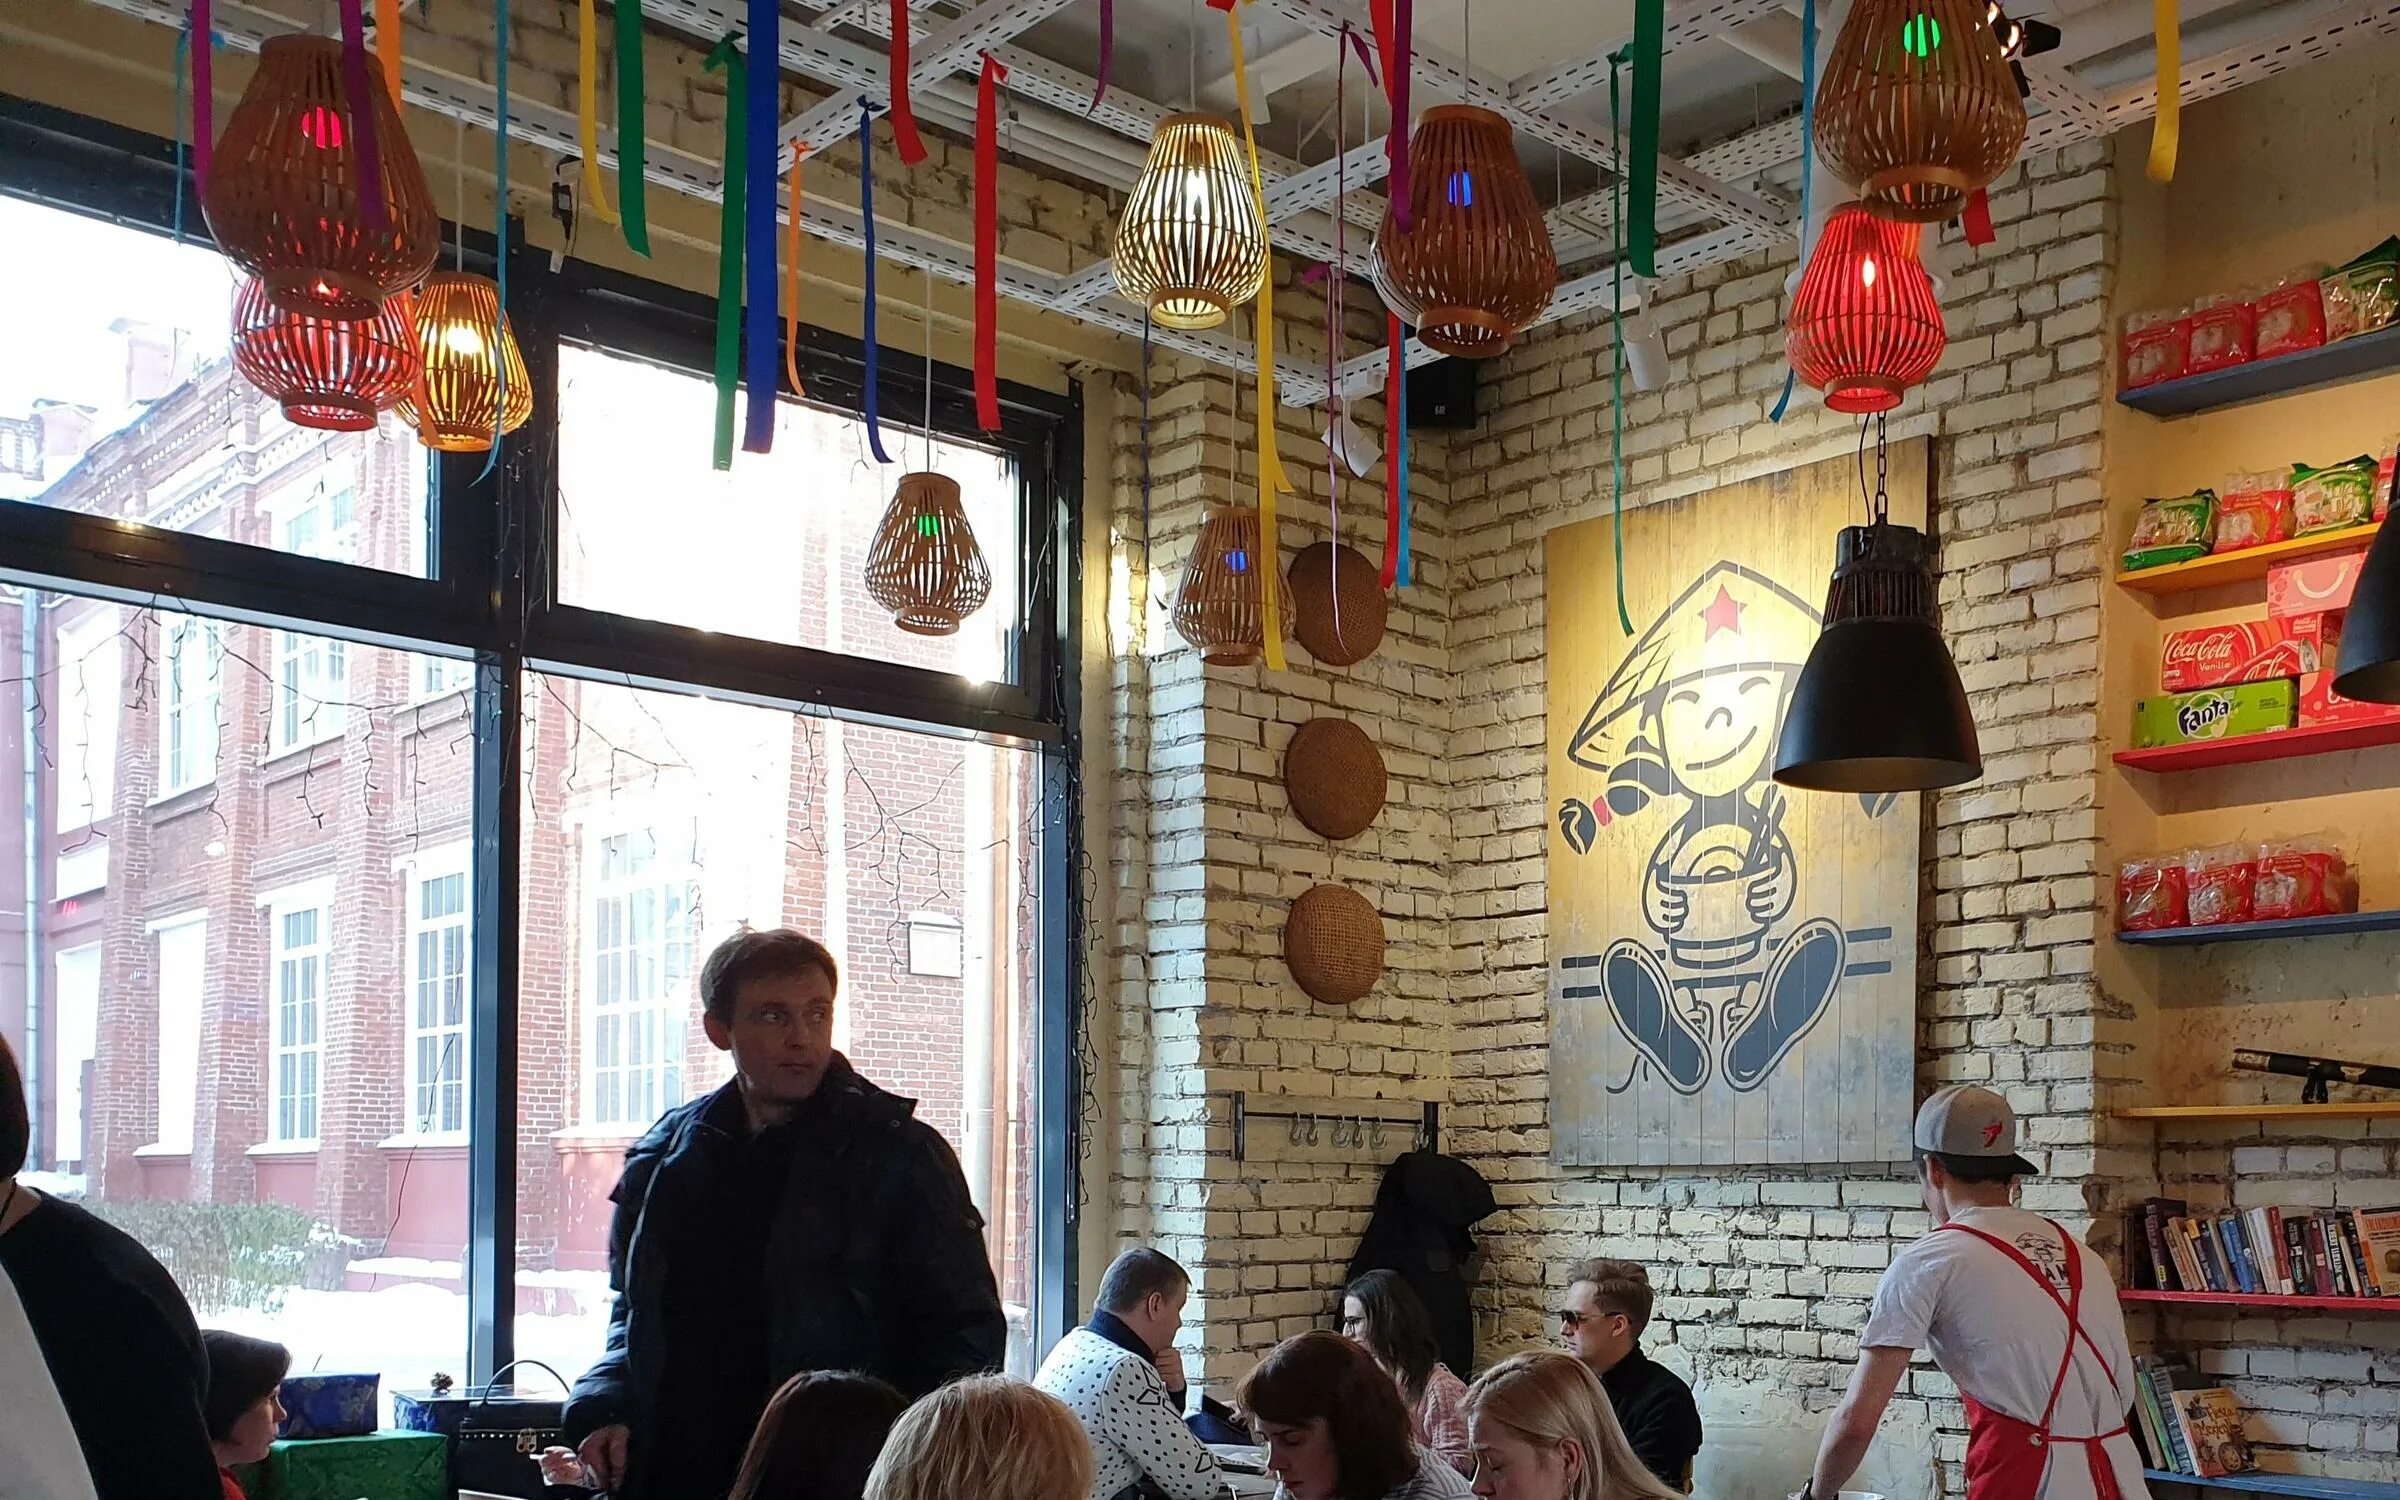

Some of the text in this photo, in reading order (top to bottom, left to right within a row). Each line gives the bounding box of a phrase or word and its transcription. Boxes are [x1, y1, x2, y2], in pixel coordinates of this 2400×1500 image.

[2165, 631, 2237, 665] Coca-Cola
[2199, 661, 2232, 672] Vanilla
[2178, 699, 2230, 737] Fanta
